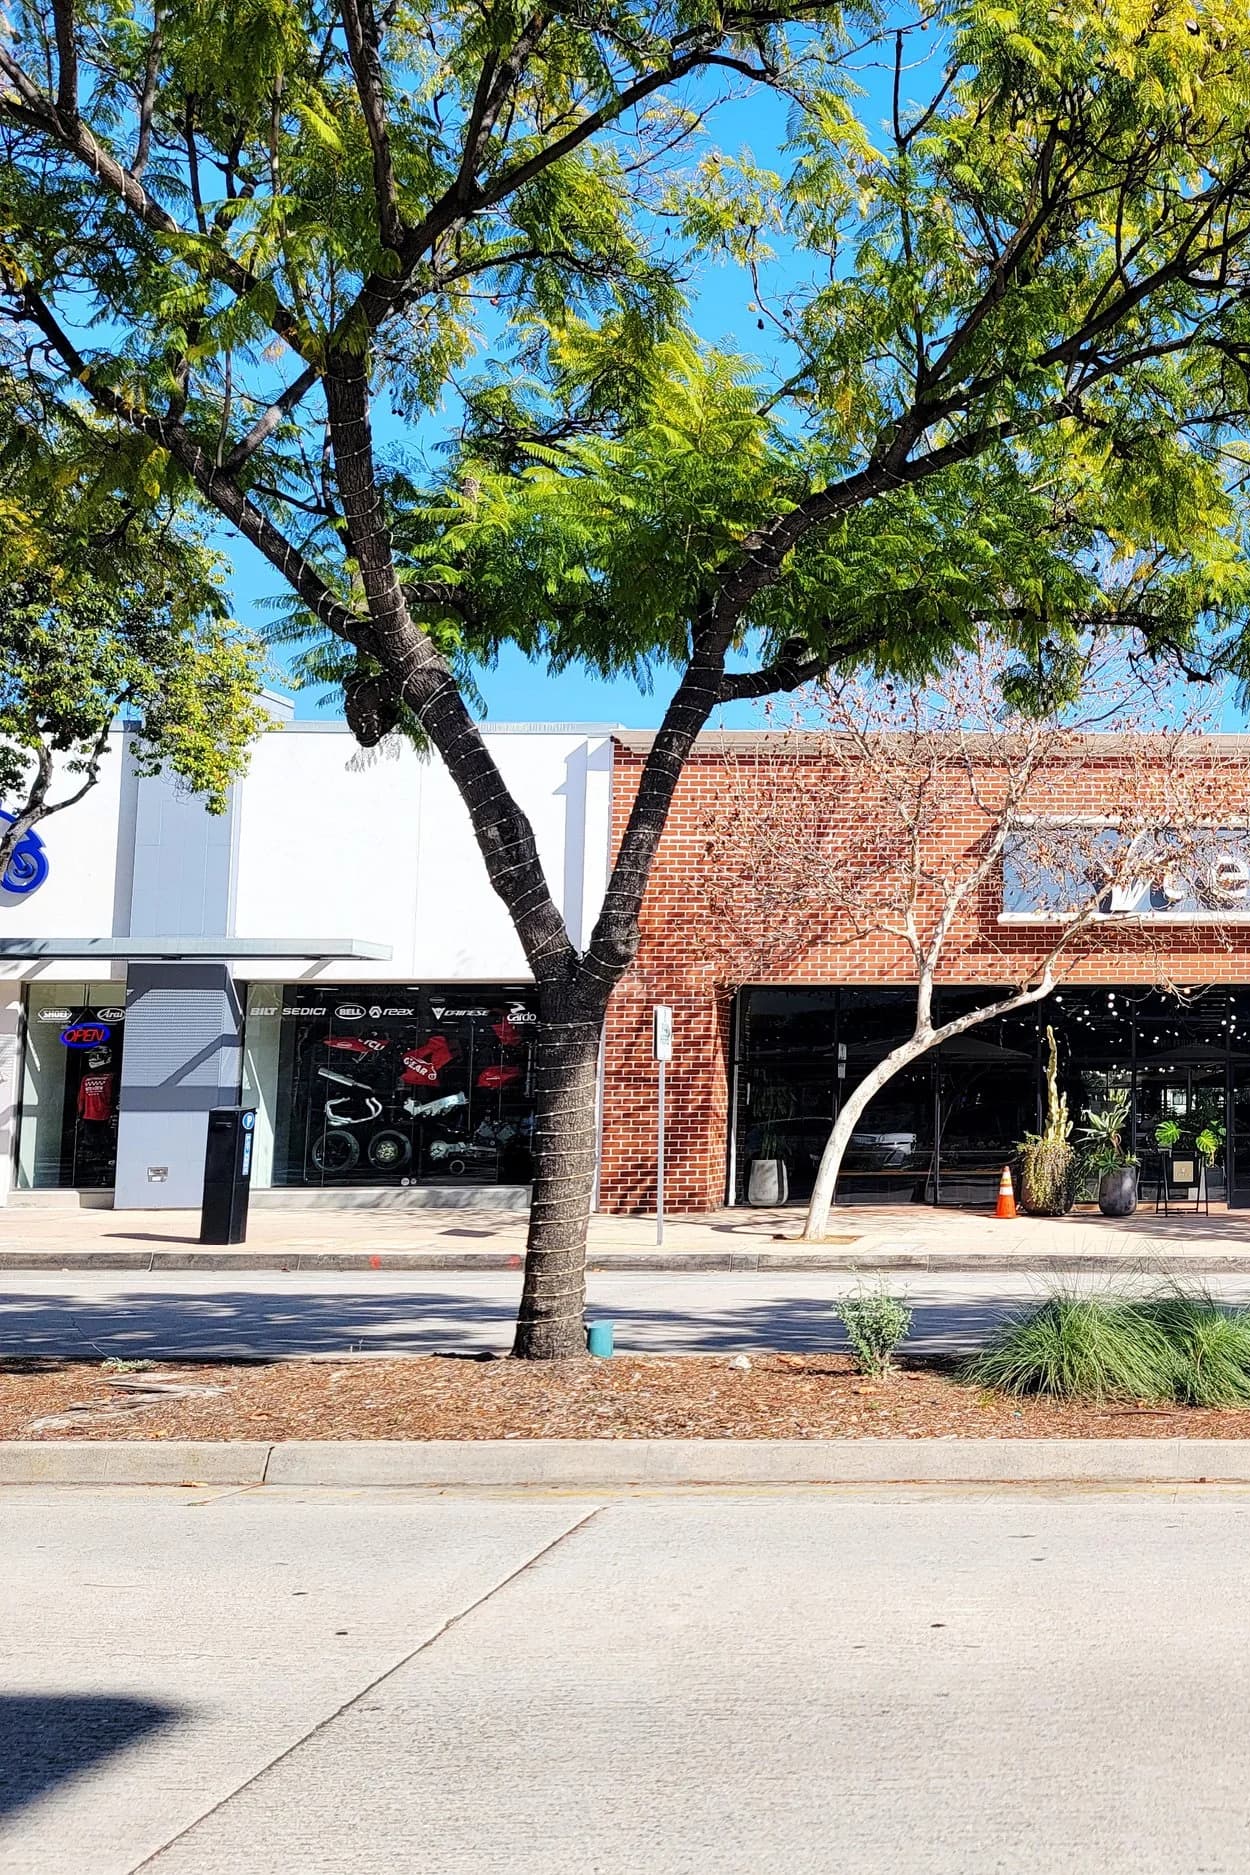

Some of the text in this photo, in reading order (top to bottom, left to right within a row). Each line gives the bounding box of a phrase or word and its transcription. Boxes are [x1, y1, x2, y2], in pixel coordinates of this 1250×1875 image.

[250, 1007, 278, 1016] BILT
[282, 1007, 327, 1016] SEDICI
[340, 1008, 361, 1016] BELL
[507, 1012, 537, 1022] cardo
[64, 1029, 104, 1042] OPEN
[403, 1057, 428, 1076] GEAR
